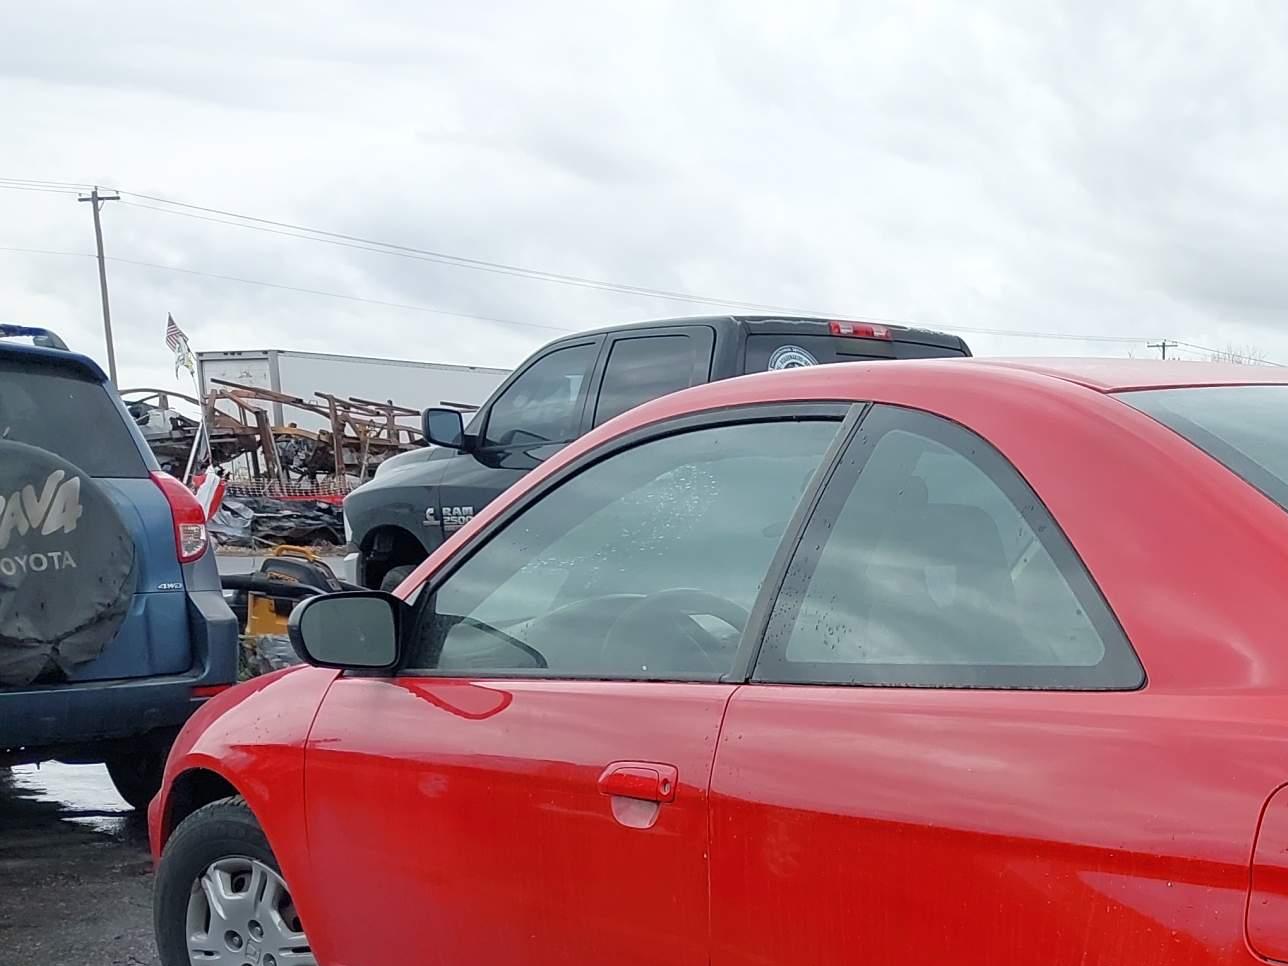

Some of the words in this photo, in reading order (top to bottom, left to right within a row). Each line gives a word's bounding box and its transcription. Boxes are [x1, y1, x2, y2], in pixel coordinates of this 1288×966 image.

[0, 469, 82, 549] AV4
[442, 506, 473, 516] RAM
[0, 551, 77, 576] OYOTA
